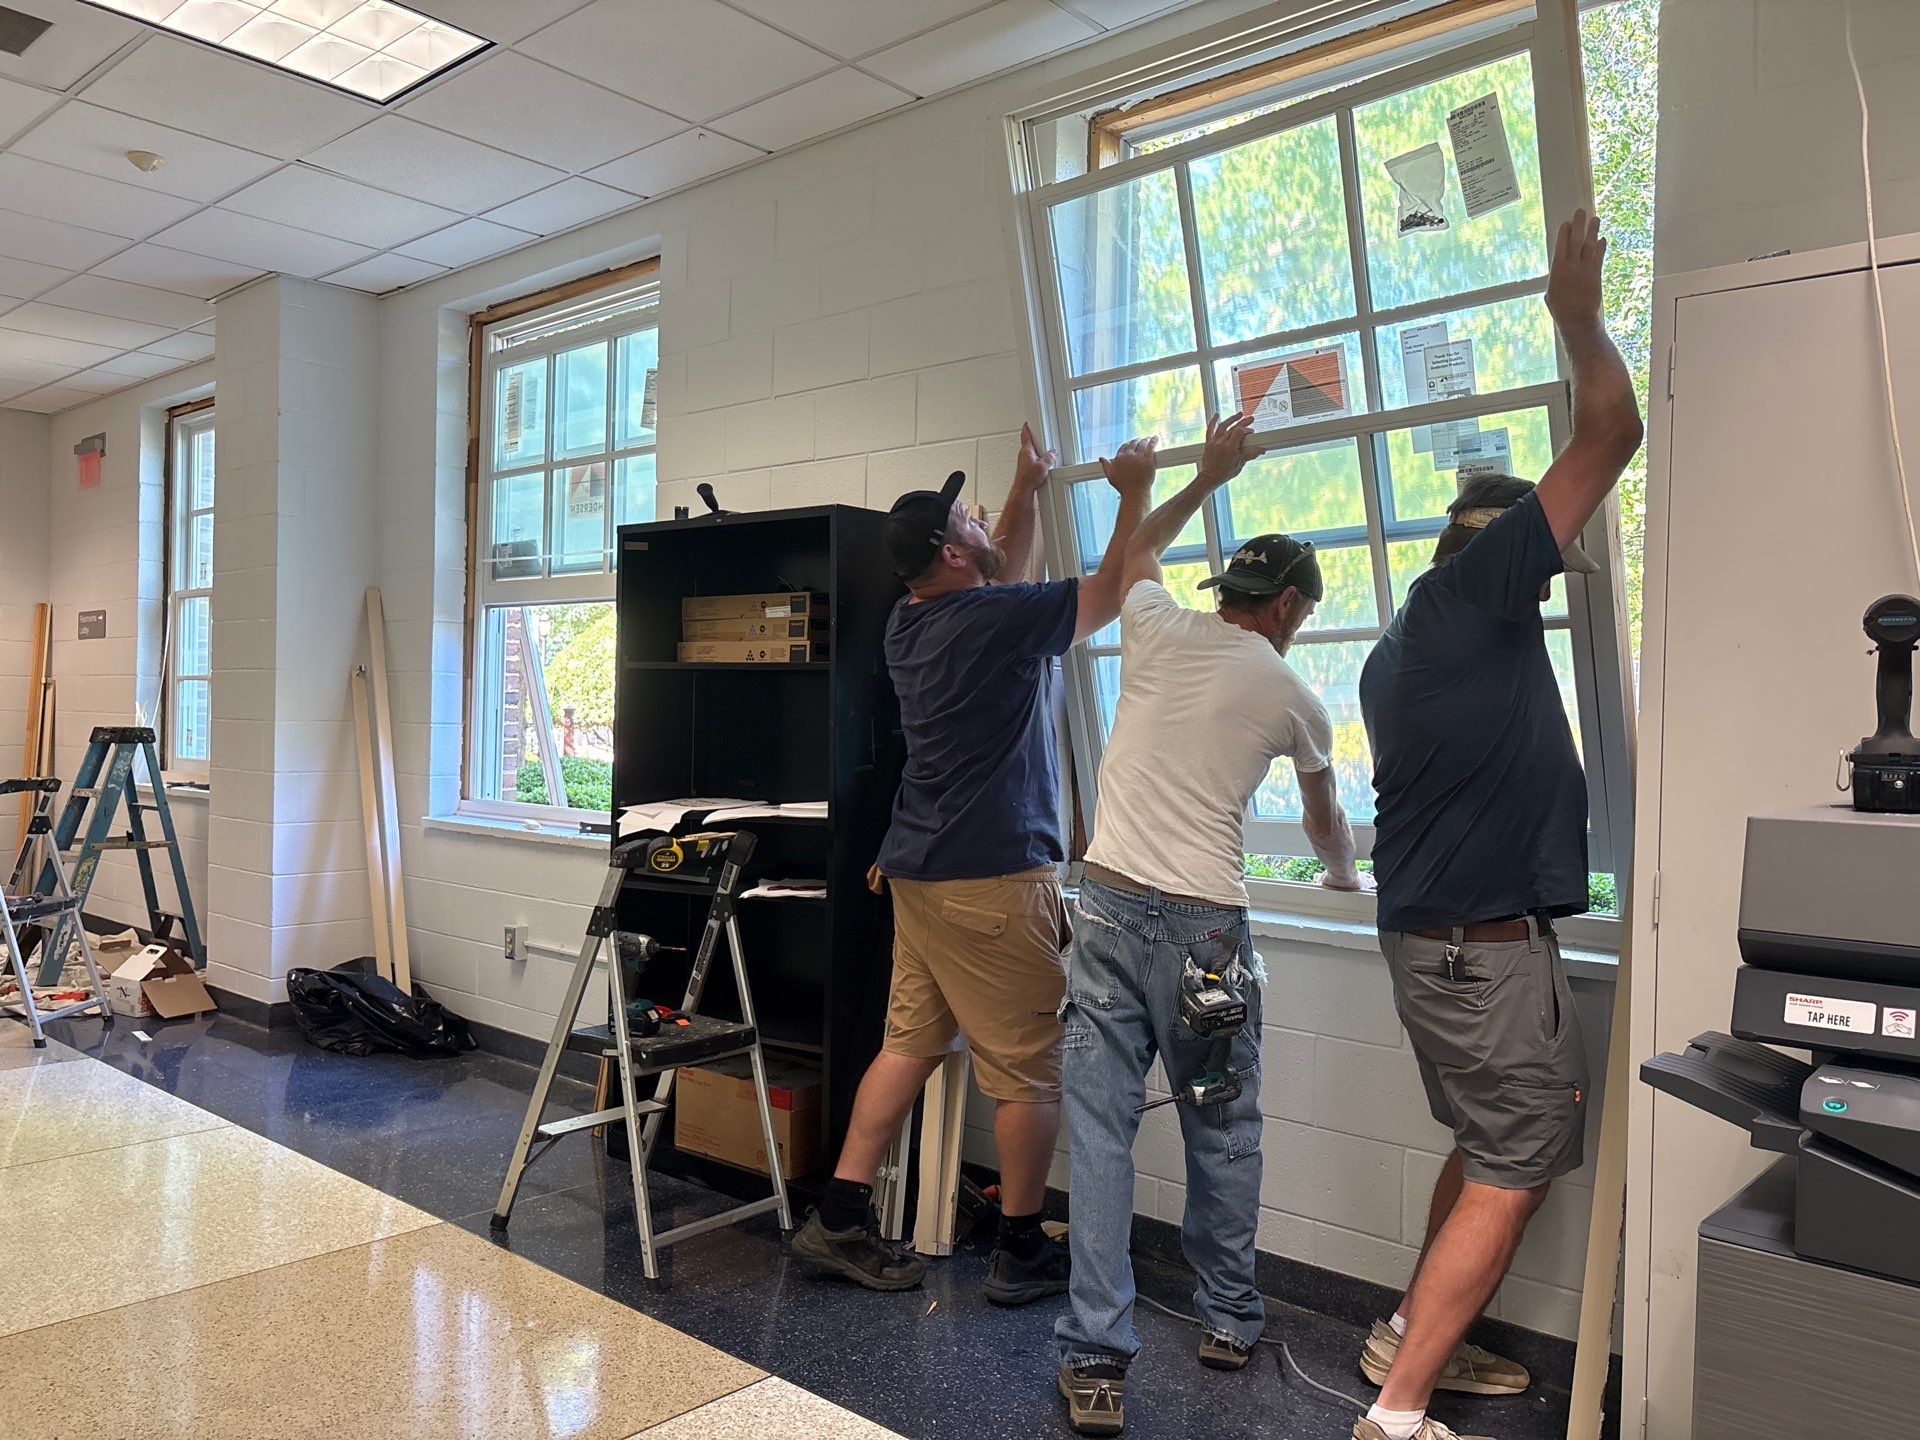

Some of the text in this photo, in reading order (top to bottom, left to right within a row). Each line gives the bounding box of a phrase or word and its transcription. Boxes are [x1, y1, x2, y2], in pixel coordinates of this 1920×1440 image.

[1789, 996, 1822, 1004] SHARP
[1807, 1011, 1851, 1027] TAP HERE
